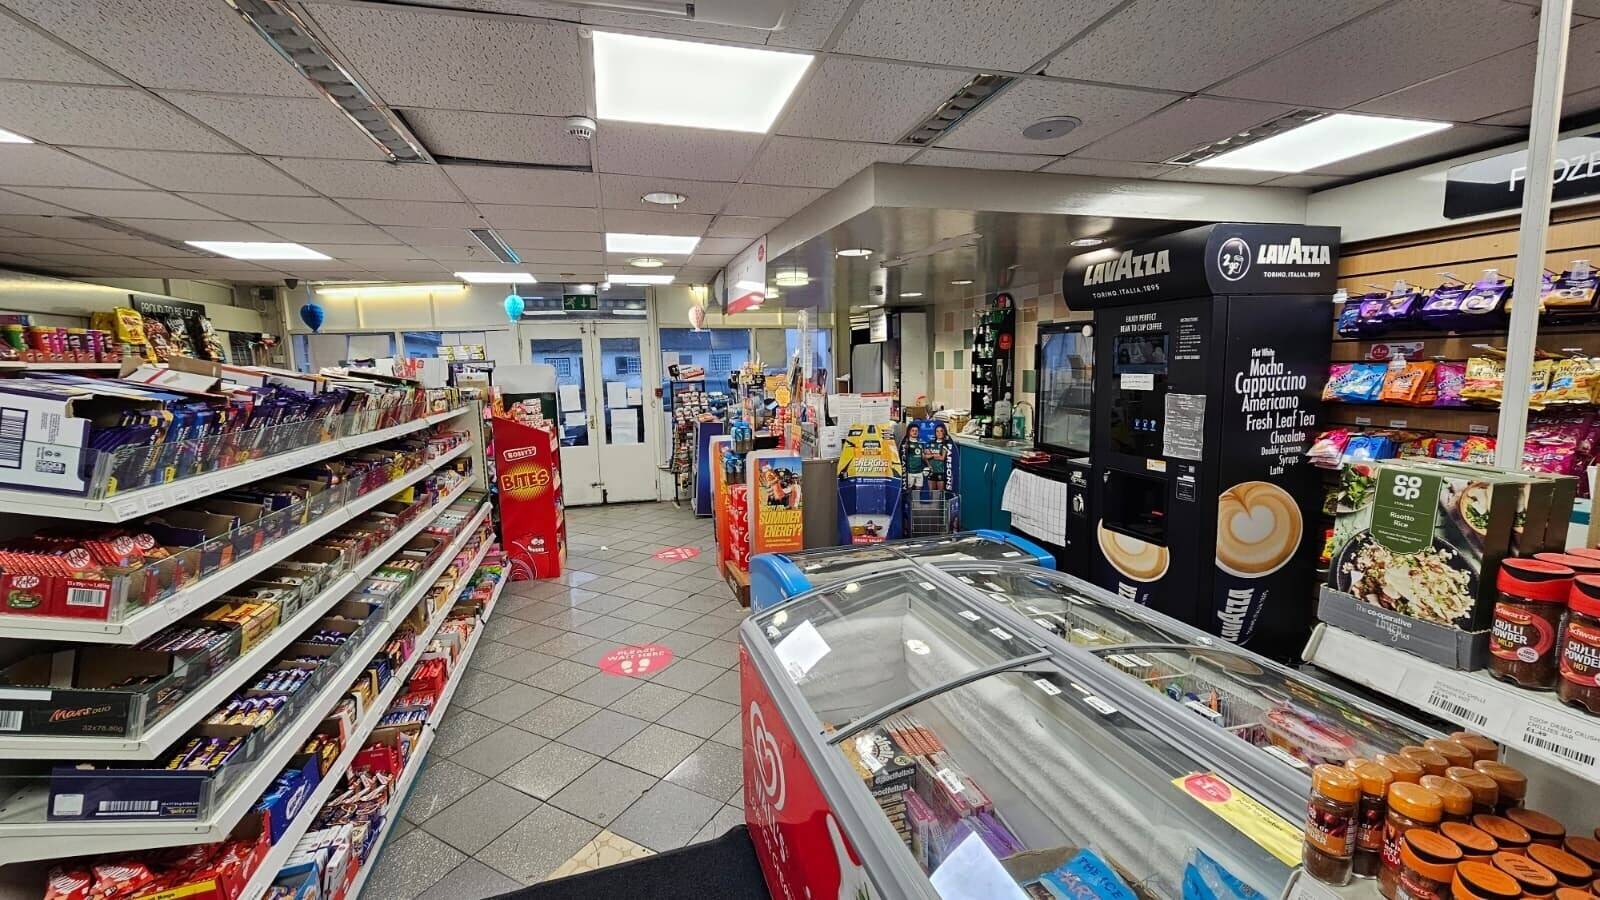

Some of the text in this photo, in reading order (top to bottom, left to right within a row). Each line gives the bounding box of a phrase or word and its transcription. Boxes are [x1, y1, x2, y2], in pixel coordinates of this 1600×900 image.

[1509, 151, 1600, 192] FOZE
[1257, 237, 1331, 265] LAVAZZA
[1083, 249, 1171, 287] LAVAZZA
[1137, 323, 1147, 332] CUP
[1146, 322, 1163, 331] COFFEE
[1250, 356, 1284, 377] Mocha
[1235, 370, 1307, 398] Cappuccino
[1241, 392, 1299, 413] Americano
[1246, 409, 1315, 432] Fresh Leaf Tea
[1270, 428, 1306, 444] Chocolate
[1261, 444, 1302, 456] Double Espresso
[1278, 455, 1299, 467] Syrups
[1269, 466, 1284, 476] Latte
[501, 469, 550, 491] BITES
[760, 510, 801, 525] SUMMER
[1390, 511, 1415, 522] Risotto
[1393, 519, 1409, 528] Rice
[763, 524, 803, 538] ENERGY?
[1367, 609, 1412, 629] co-operative
[1495, 607, 1531, 621] Schwartz
[1492, 626, 1528, 645] POWDER
[1497, 637, 1514, 648] MILD
[607, 650, 665, 662] WAIT HERE
[617, 647, 656, 656] PLEASE
[1573, 662, 1588, 672] HOT
[48, 705, 112, 722] Mars DUO
[872, 783, 909, 798] oodfella's
[1080, 856, 1100, 876] THE
